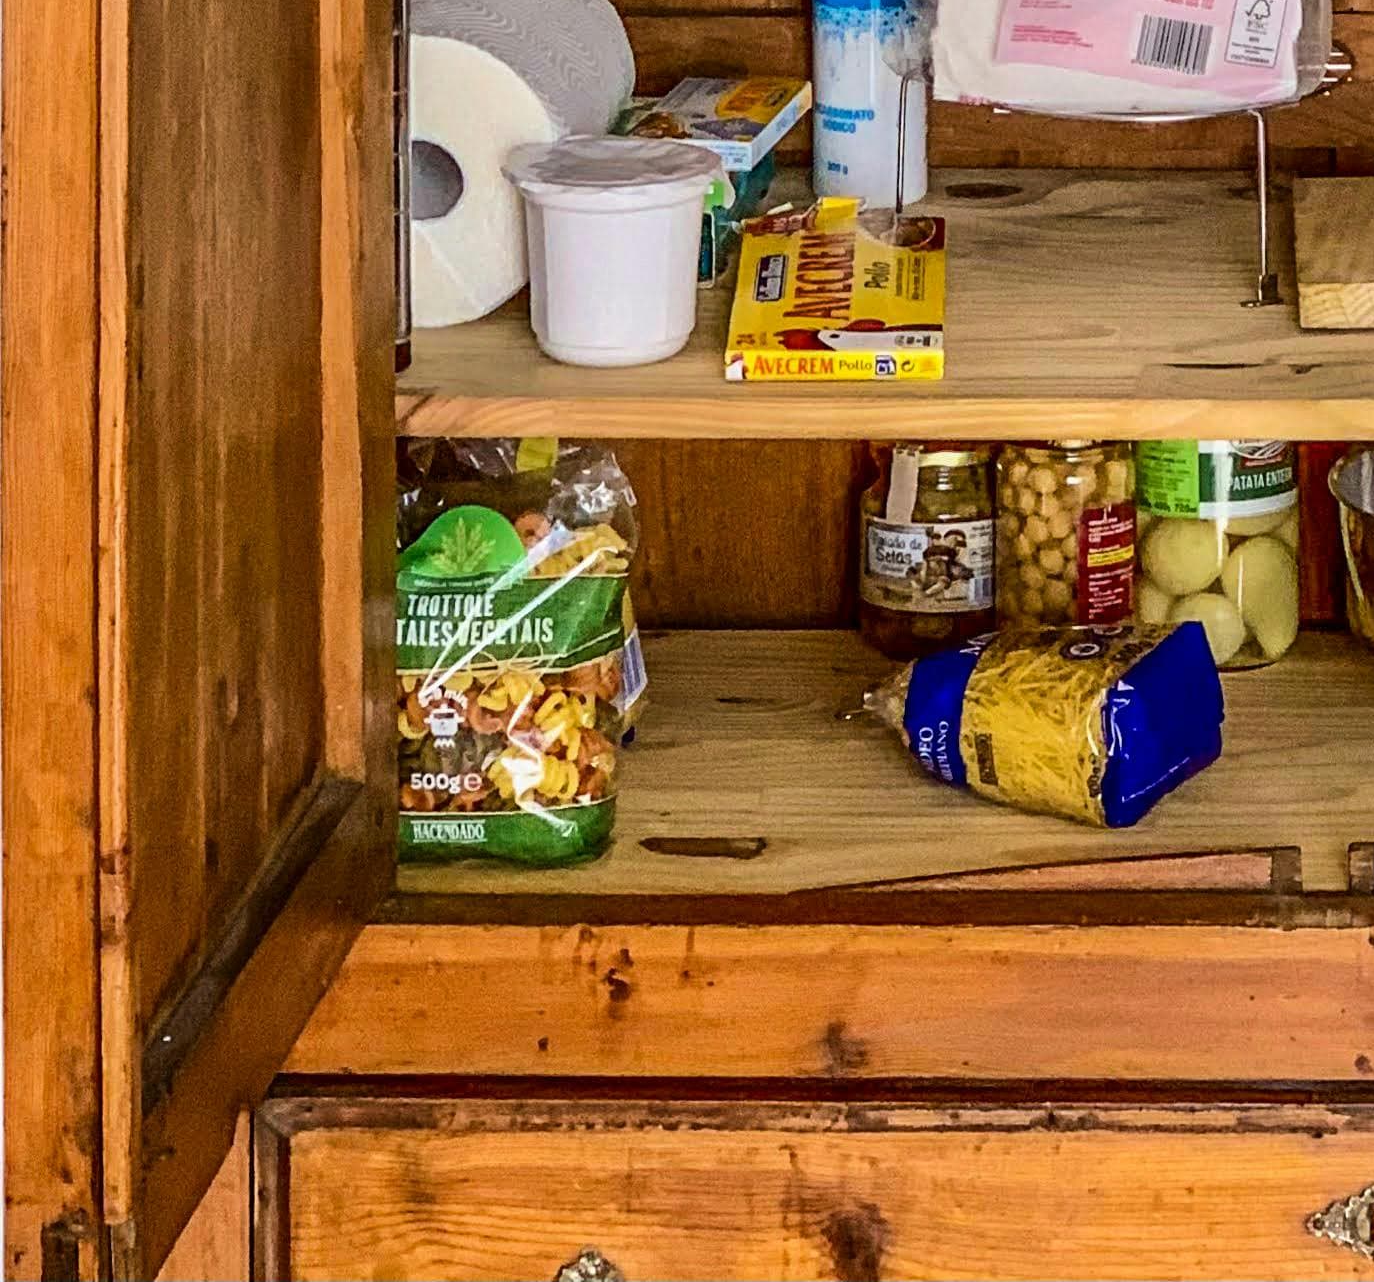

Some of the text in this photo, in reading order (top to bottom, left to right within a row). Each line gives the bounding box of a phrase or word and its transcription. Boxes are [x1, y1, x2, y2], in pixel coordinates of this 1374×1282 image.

[863, 261, 891, 290] Pollo
[752, 355, 873, 376] AVECREM Pollo
[407, 593, 496, 618] TROTTOLE
[409, 773, 461, 795] 500g
[412, 823, 486, 841] HACENDADO
